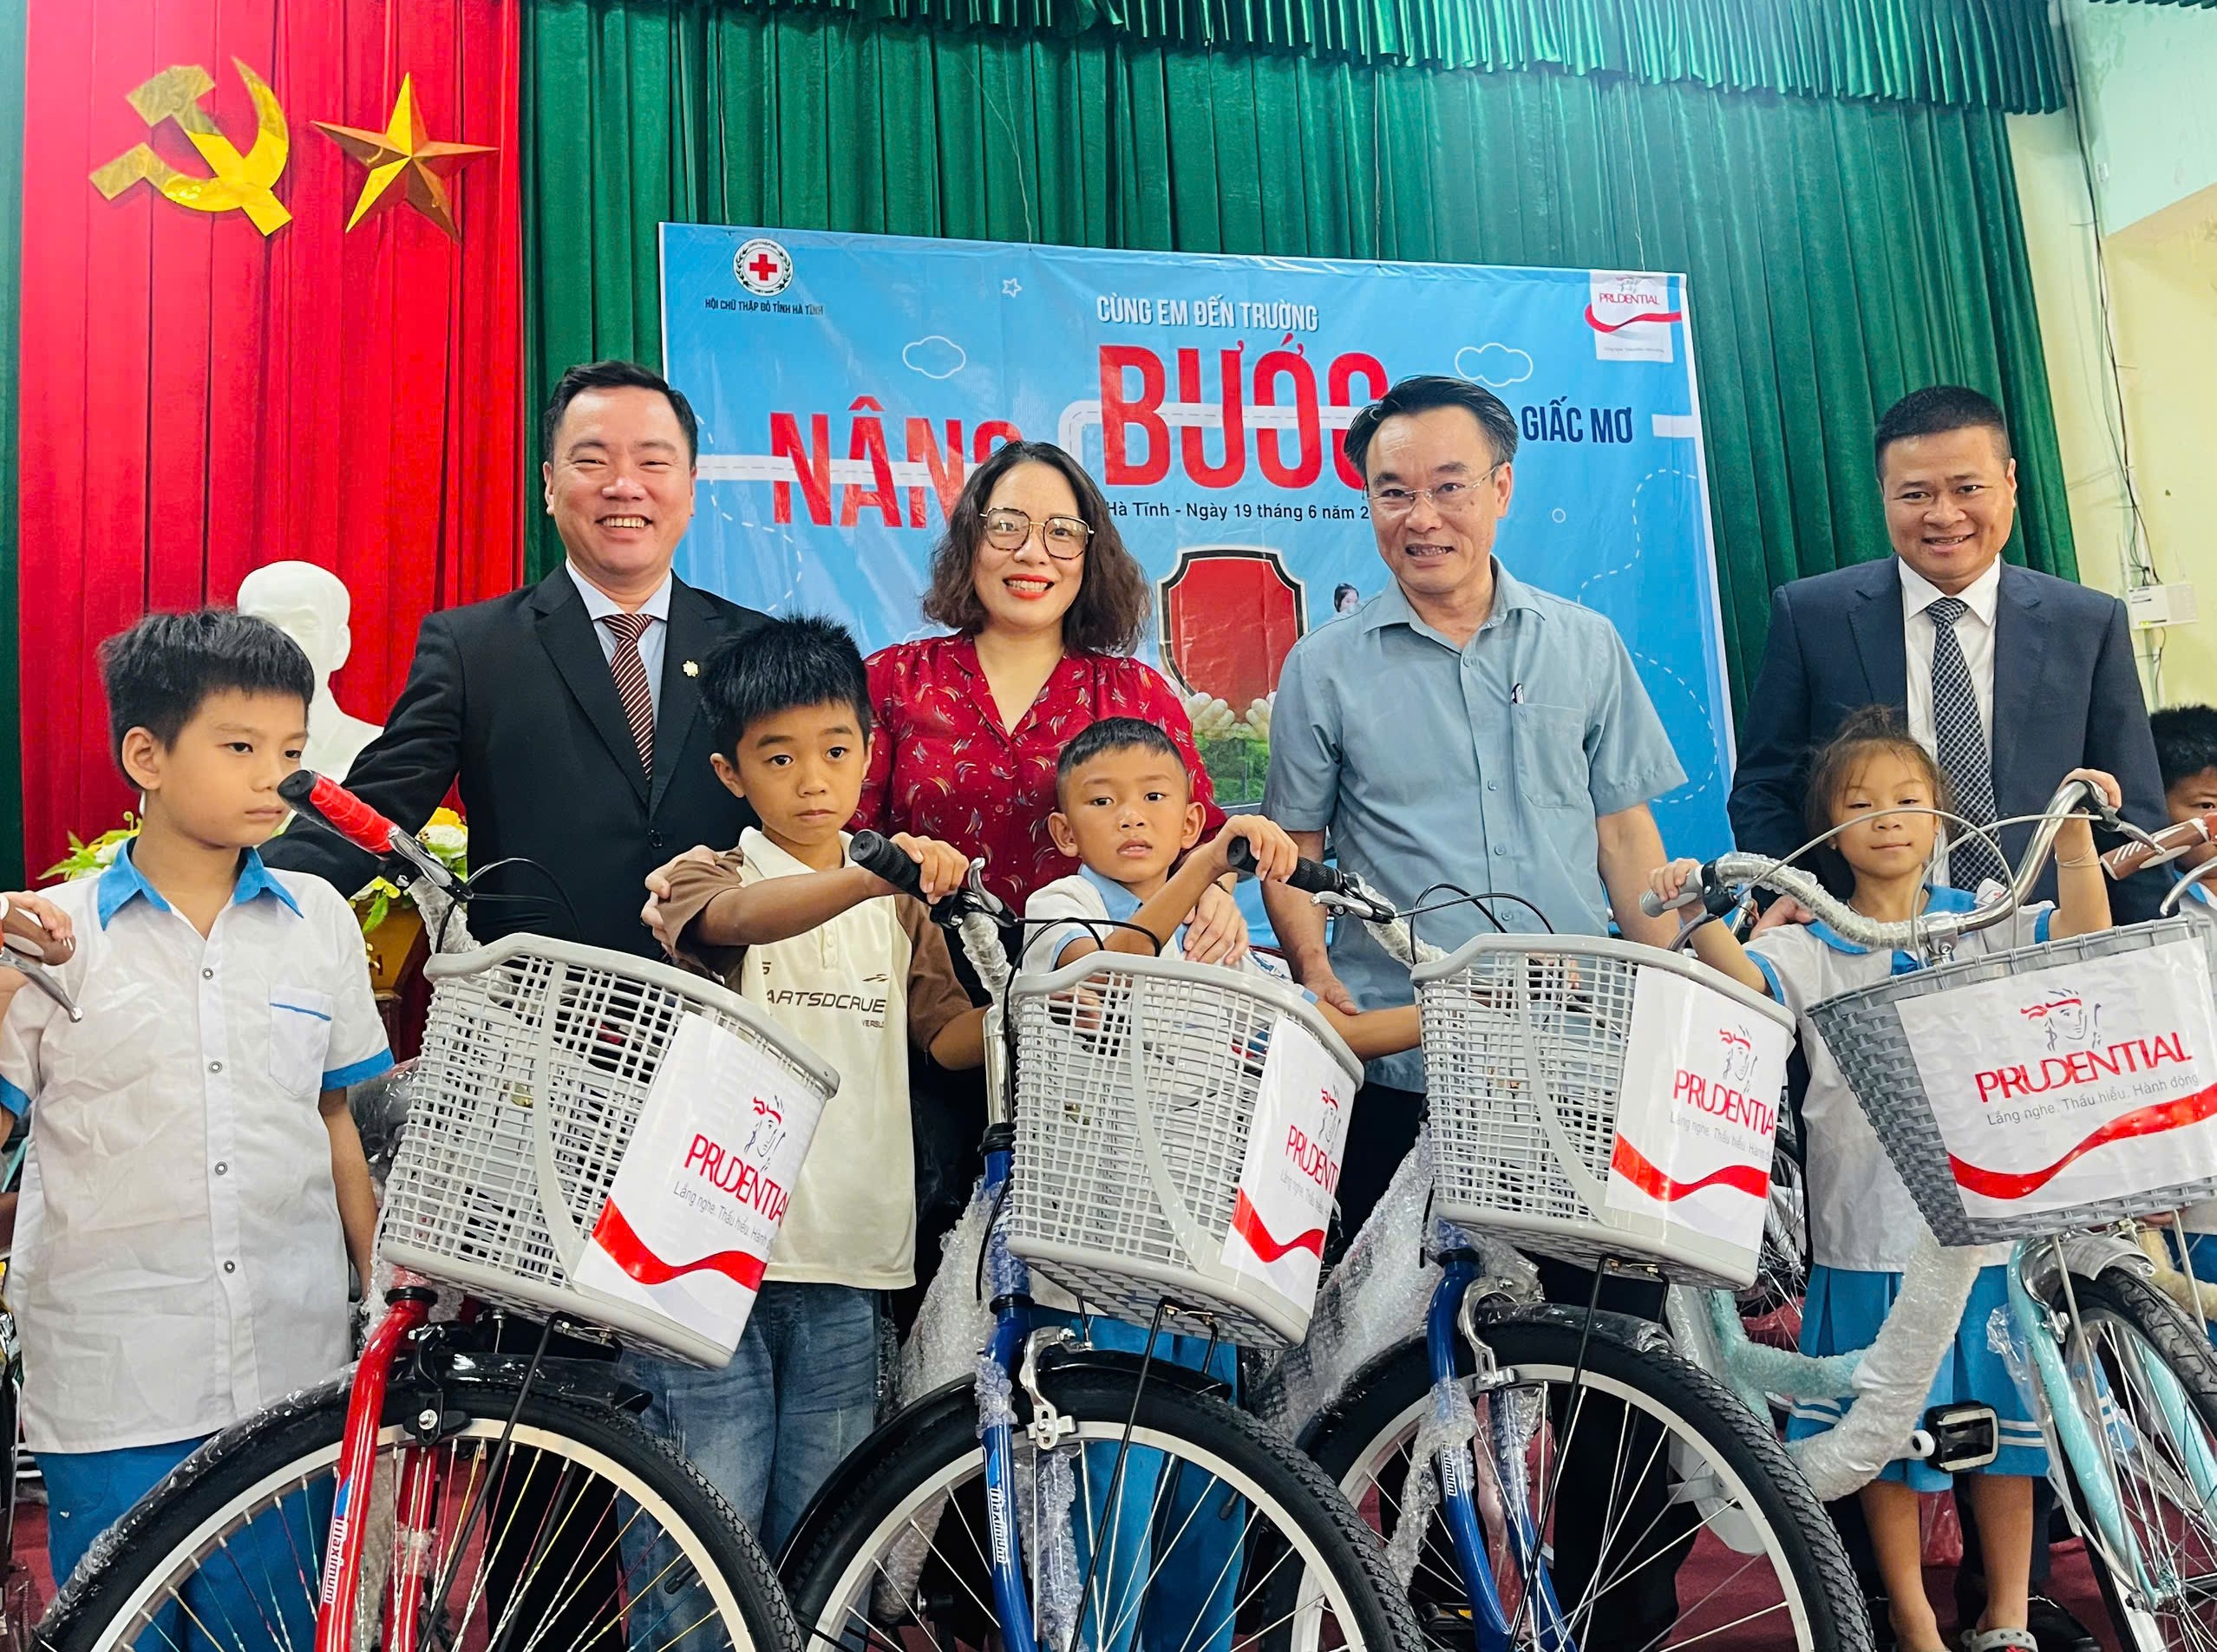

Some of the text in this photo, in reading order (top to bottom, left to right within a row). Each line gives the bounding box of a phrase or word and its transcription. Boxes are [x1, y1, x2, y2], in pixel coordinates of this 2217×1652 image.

[705, 297, 718, 310] HỘI
[720, 299, 736, 310] CHỮ
[738, 300, 759, 312] THẬP
[1096, 292, 1318, 332] CÙNG EM ĐẾN TRƯỜNG
[1599, 293, 1660, 305] PRUDENTIAL
[1521, 395, 1633, 444] GIẤC MƠ
[1108, 500, 1128, 517] Hà
[1132, 501, 1170, 517] Tĩnh
[1187, 503, 1227, 521] Ngày
[1233, 504, 1252, 518] 19
[1258, 504, 1302, 521] tháng
[1308, 505, 1317, 519] 6
[1322, 504, 1355, 519] năm
[1360, 506, 1370, 519] 2
[1974, 1032, 2194, 1103] PRUDENTIAL
[1673, 1068, 1776, 1140] PRUDENTIA
[1987, 1110, 2021, 1126] Lắng
[2061, 1095, 2096, 1111] Thấu
[2132, 1079, 2168, 1097] Hành
[2170, 1073, 2200, 1089] động
[683, 1133, 790, 1229] PRUDENTIA
